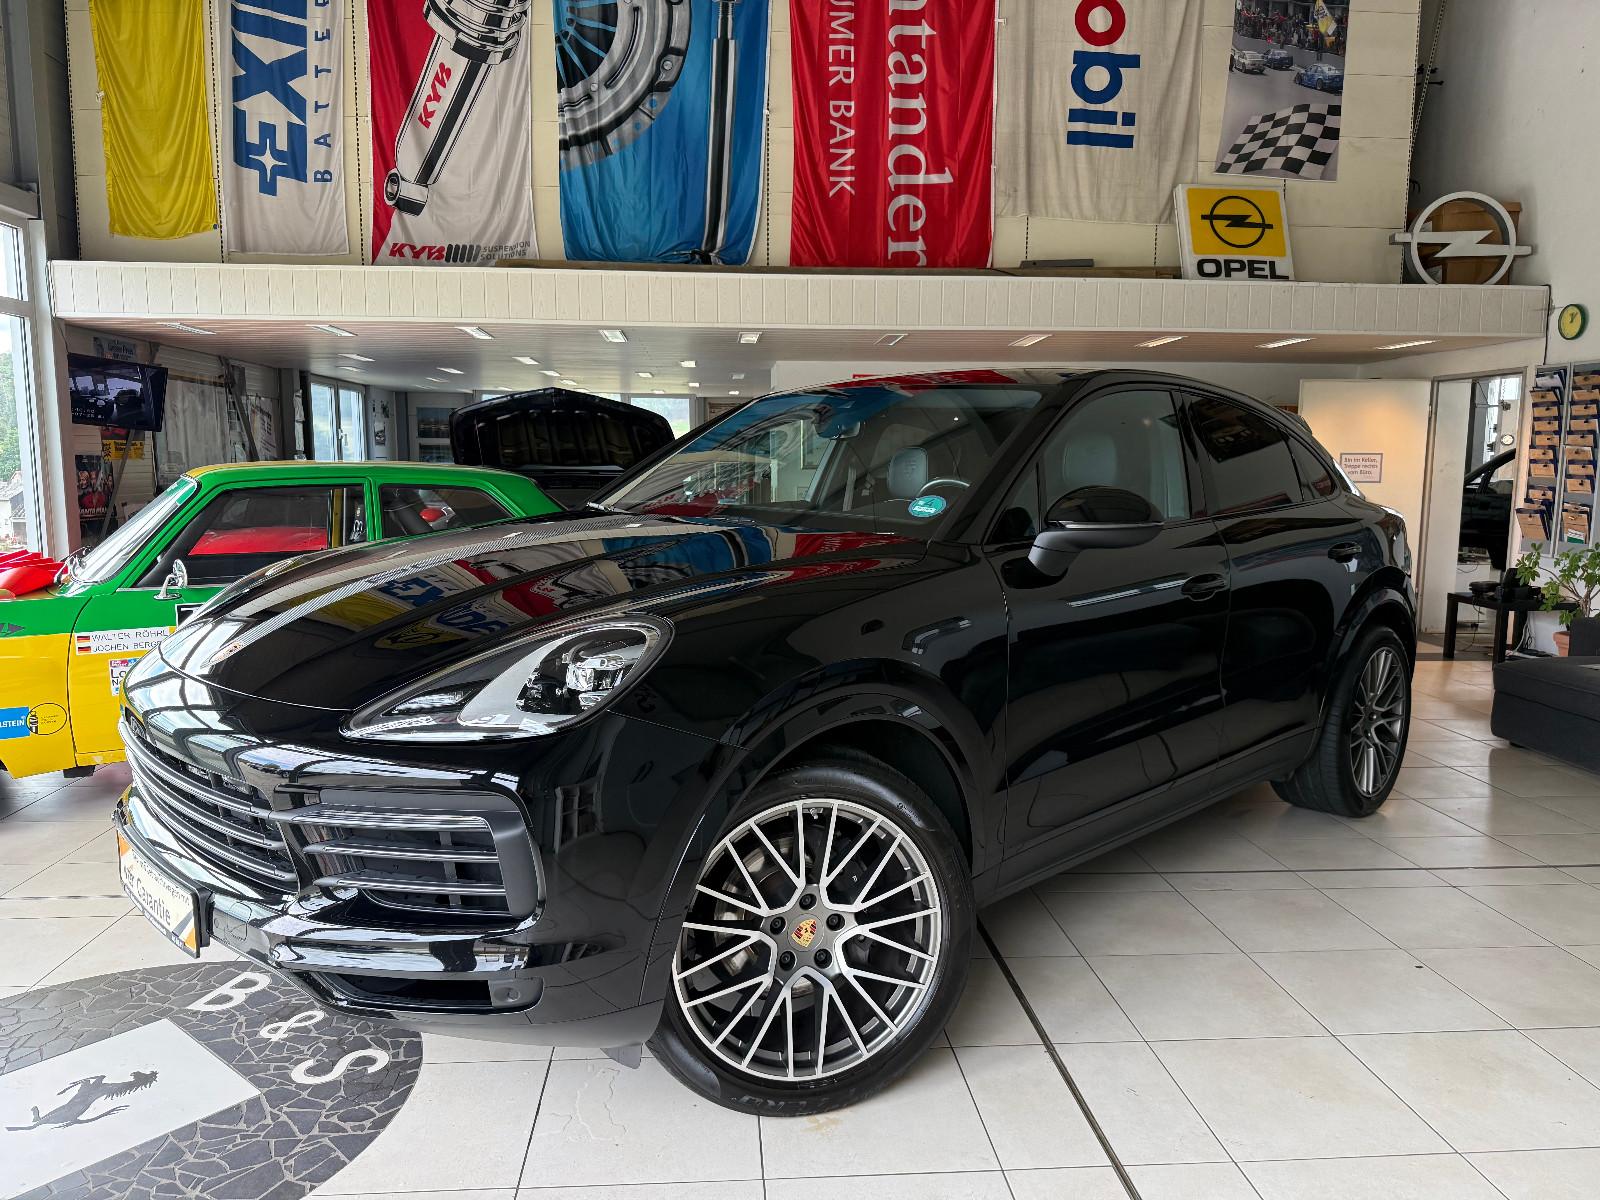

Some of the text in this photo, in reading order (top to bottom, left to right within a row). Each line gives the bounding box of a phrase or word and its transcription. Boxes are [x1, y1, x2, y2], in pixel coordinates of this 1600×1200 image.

[418, 62, 452, 129] KYB
[1066, 0, 1141, 149] obil
[829, 100, 856, 198] BANK
[389, 242, 446, 261] KYB
[1196, 258, 1290, 280] OPEL
[91, 629, 169, 642] WALTER RÖHRL
[93, 643, 129, 653] JOCHEN
[185, 971, 391, 1085] B & S
